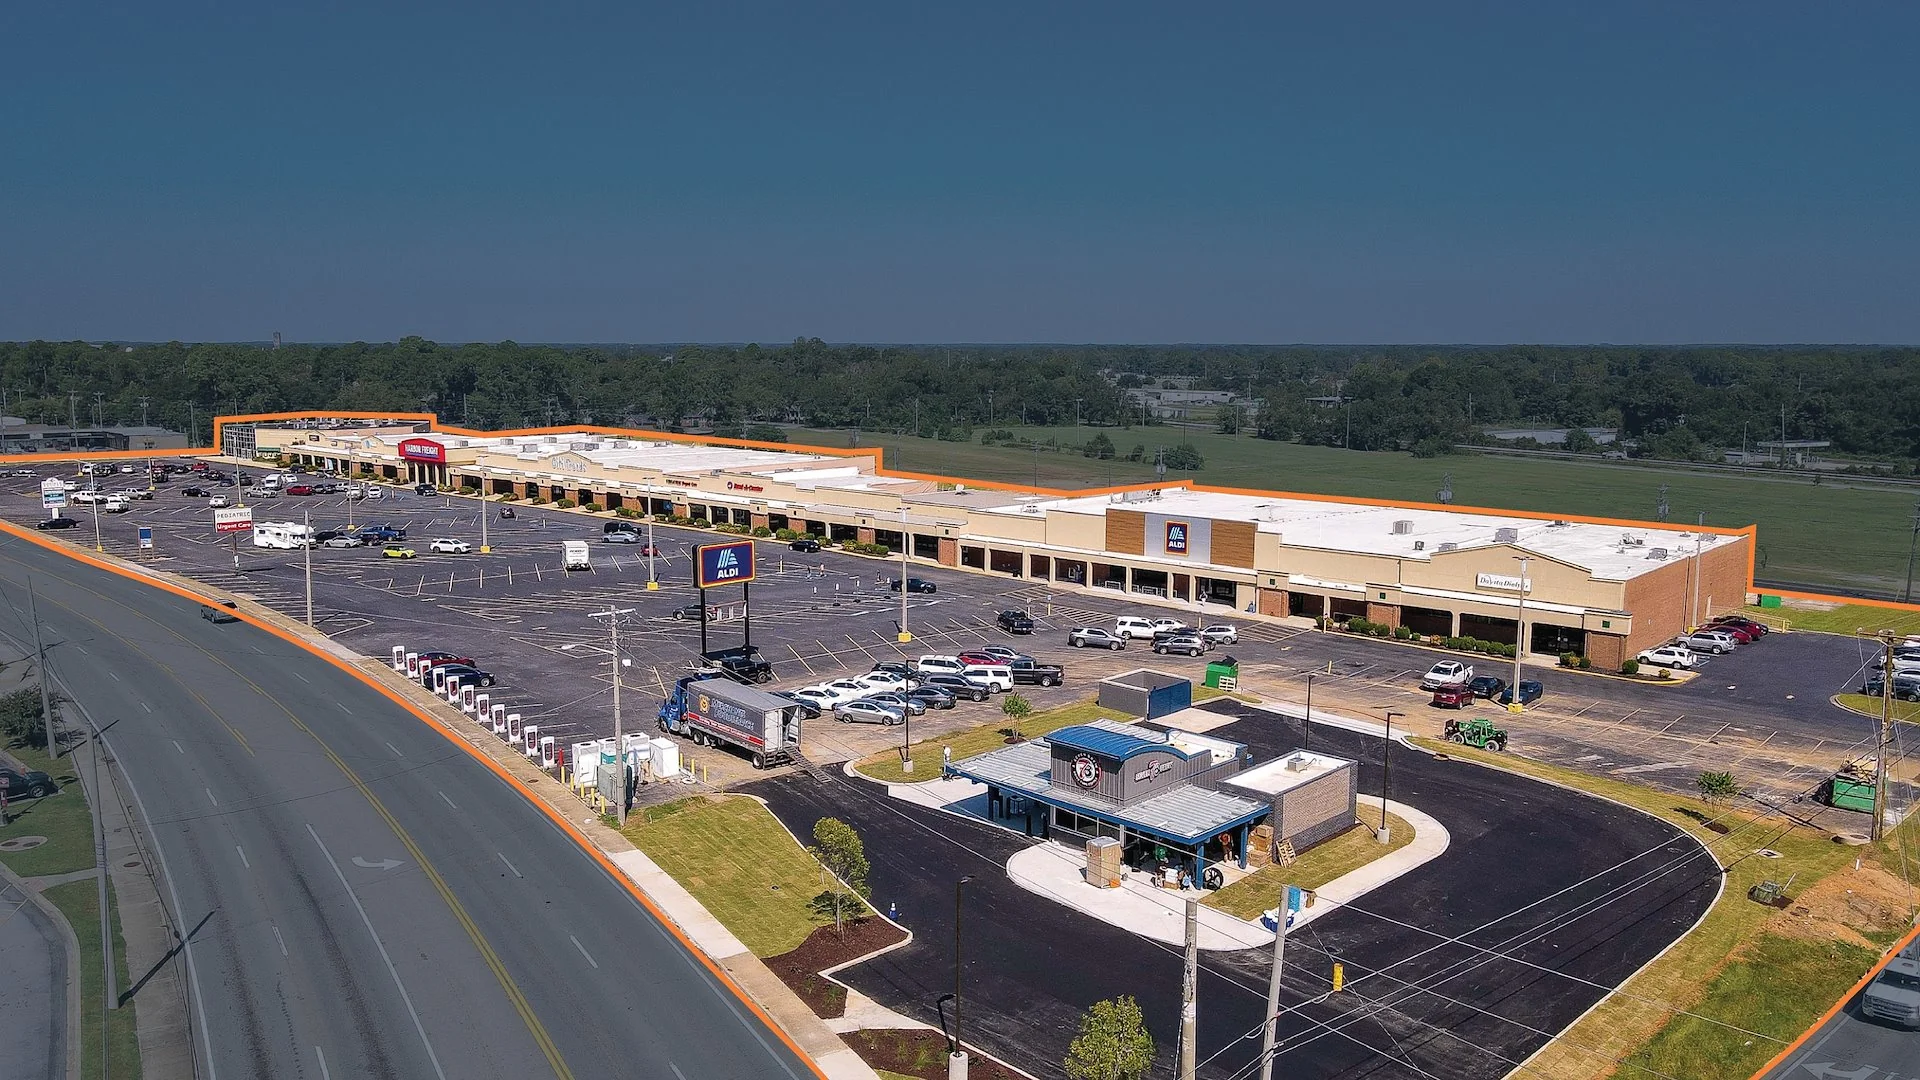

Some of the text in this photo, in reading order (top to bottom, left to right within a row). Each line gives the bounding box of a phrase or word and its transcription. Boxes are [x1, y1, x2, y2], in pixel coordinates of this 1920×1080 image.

[216, 511, 251, 519] PEDIATRIC
[217, 522, 238, 530] Urgent
[1168, 541, 1185, 549] ALDI
[717, 567, 739, 579] ALDI
